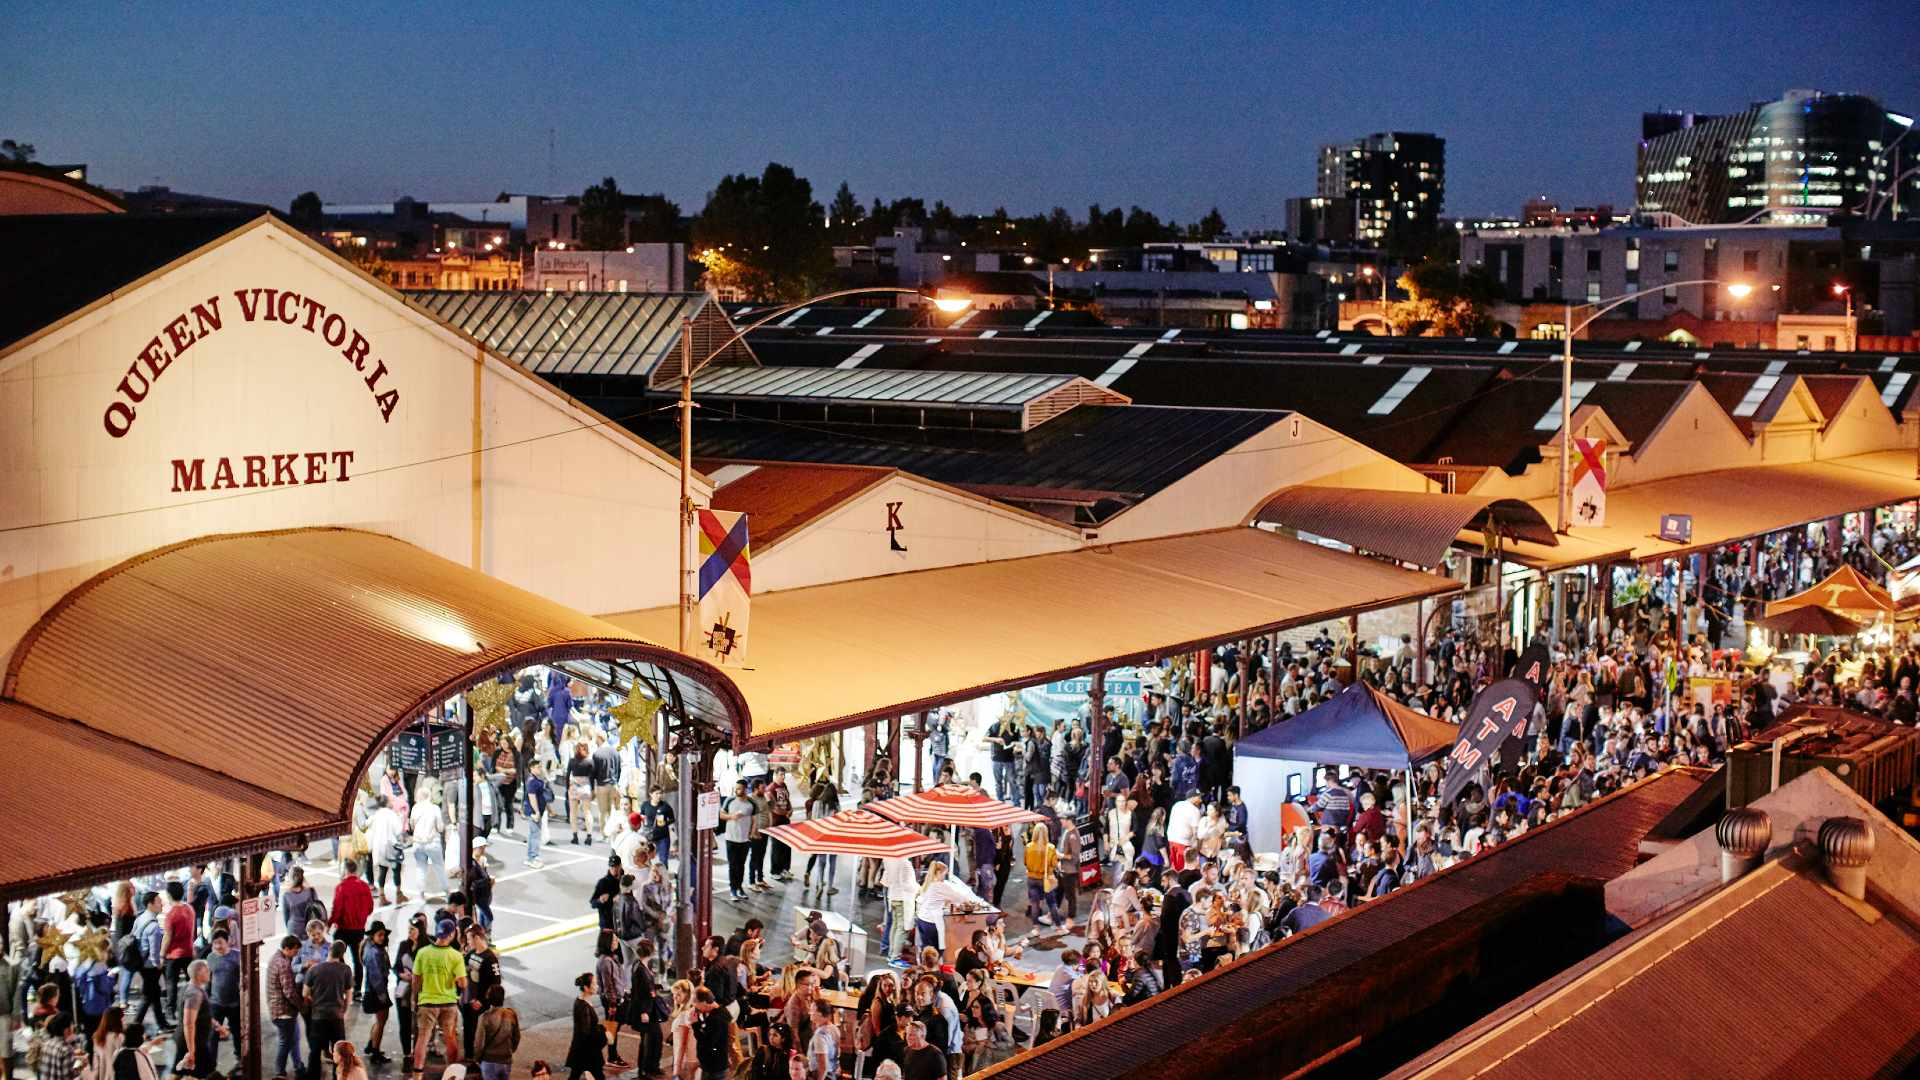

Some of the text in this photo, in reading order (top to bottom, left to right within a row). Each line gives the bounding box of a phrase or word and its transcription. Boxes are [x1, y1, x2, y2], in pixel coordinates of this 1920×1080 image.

[103, 289, 400, 438] QUEEN VICTORIA
[1292, 420, 1299, 437] J
[171, 451, 354, 492] MARKET
[886, 501, 904, 531] K
[1451, 697, 1517, 770] ATM
[1080, 848, 1098, 863] HERE
